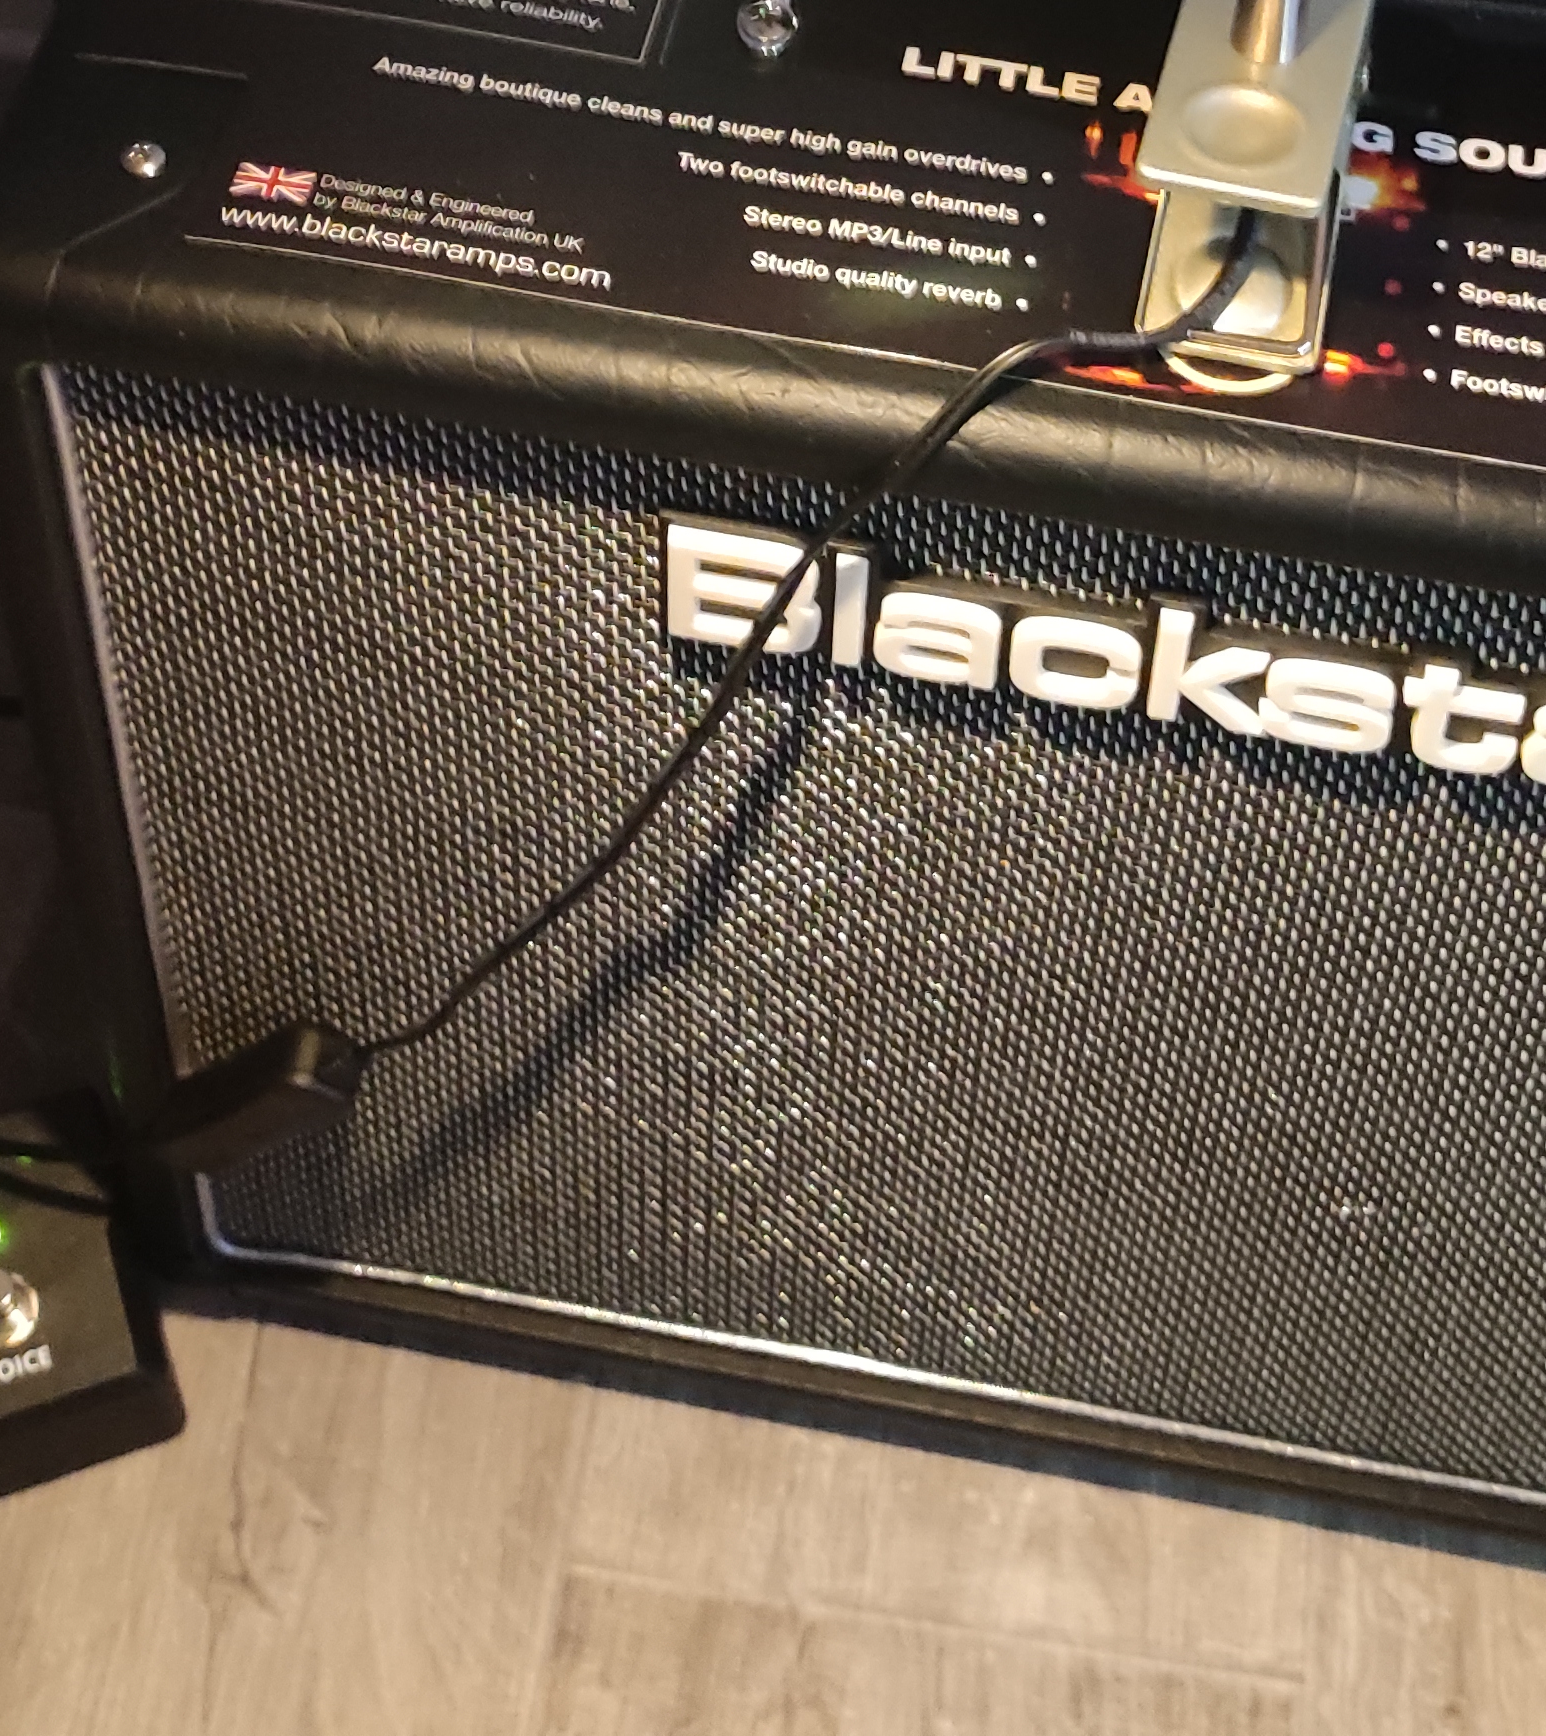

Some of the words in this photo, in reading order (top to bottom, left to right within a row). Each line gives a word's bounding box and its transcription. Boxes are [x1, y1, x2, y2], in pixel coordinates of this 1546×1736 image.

[900, 46, 1102, 107] LITTLE
[371, 55, 476, 94] Amazing
[479, 73, 583, 109] boutique
[587, 95, 663, 127] cleans
[667, 110, 714, 136] and
[717, 118, 786, 146] super
[790, 127, 842, 157] high
[846, 138, 899, 163] gain
[903, 146, 1030, 186] overdrives
[319, 173, 407, 202] Designed
[411, 187, 425, 206] &
[429, 191, 535, 226] Engineered
[676, 150, 725, 179] Two
[729, 160, 905, 206] footswitchable
[910, 190, 1021, 226] channels
[220, 205, 613, 293] www.blackstaramps.com
[313, 190, 338, 210] by
[341, 195, 428, 225] Blackstar
[431, 210, 550, 249] Amplification
[553, 233, 586, 256] UK
[743, 205, 823, 237] Stereo
[827, 217, 944, 255] MP3/Line
[947, 237, 1012, 268] input
[750, 249, 831, 283] Studio
[834, 267, 918, 299] quality
[922, 280, 1003, 312] reverb
[1454, 324, 1546, 358] Effects
